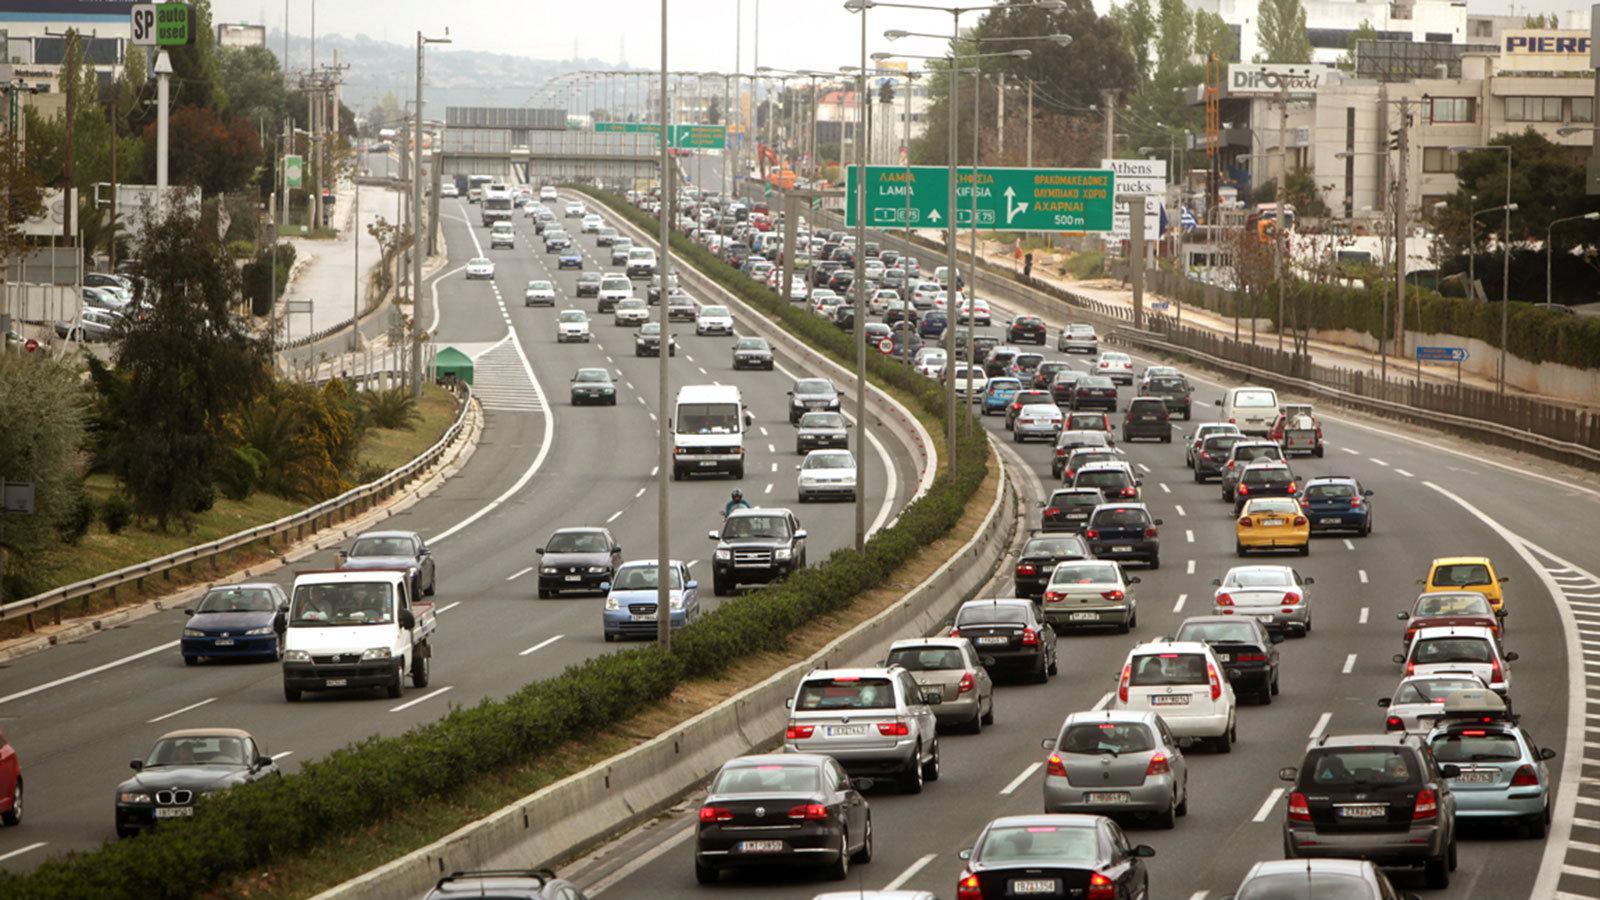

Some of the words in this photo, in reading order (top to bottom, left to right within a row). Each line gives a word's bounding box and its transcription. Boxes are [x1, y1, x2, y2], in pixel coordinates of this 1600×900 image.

[159, 7, 186, 22] auto
[134, 10, 154, 39] SP
[160, 25, 186, 38] used
[879, 186, 915, 196] LAMIA
[1033, 201, 1084, 212] ΑΧΑΡΝΑΙ
[1054, 215, 1073, 225] 500
[1074, 217, 1085, 225] m
